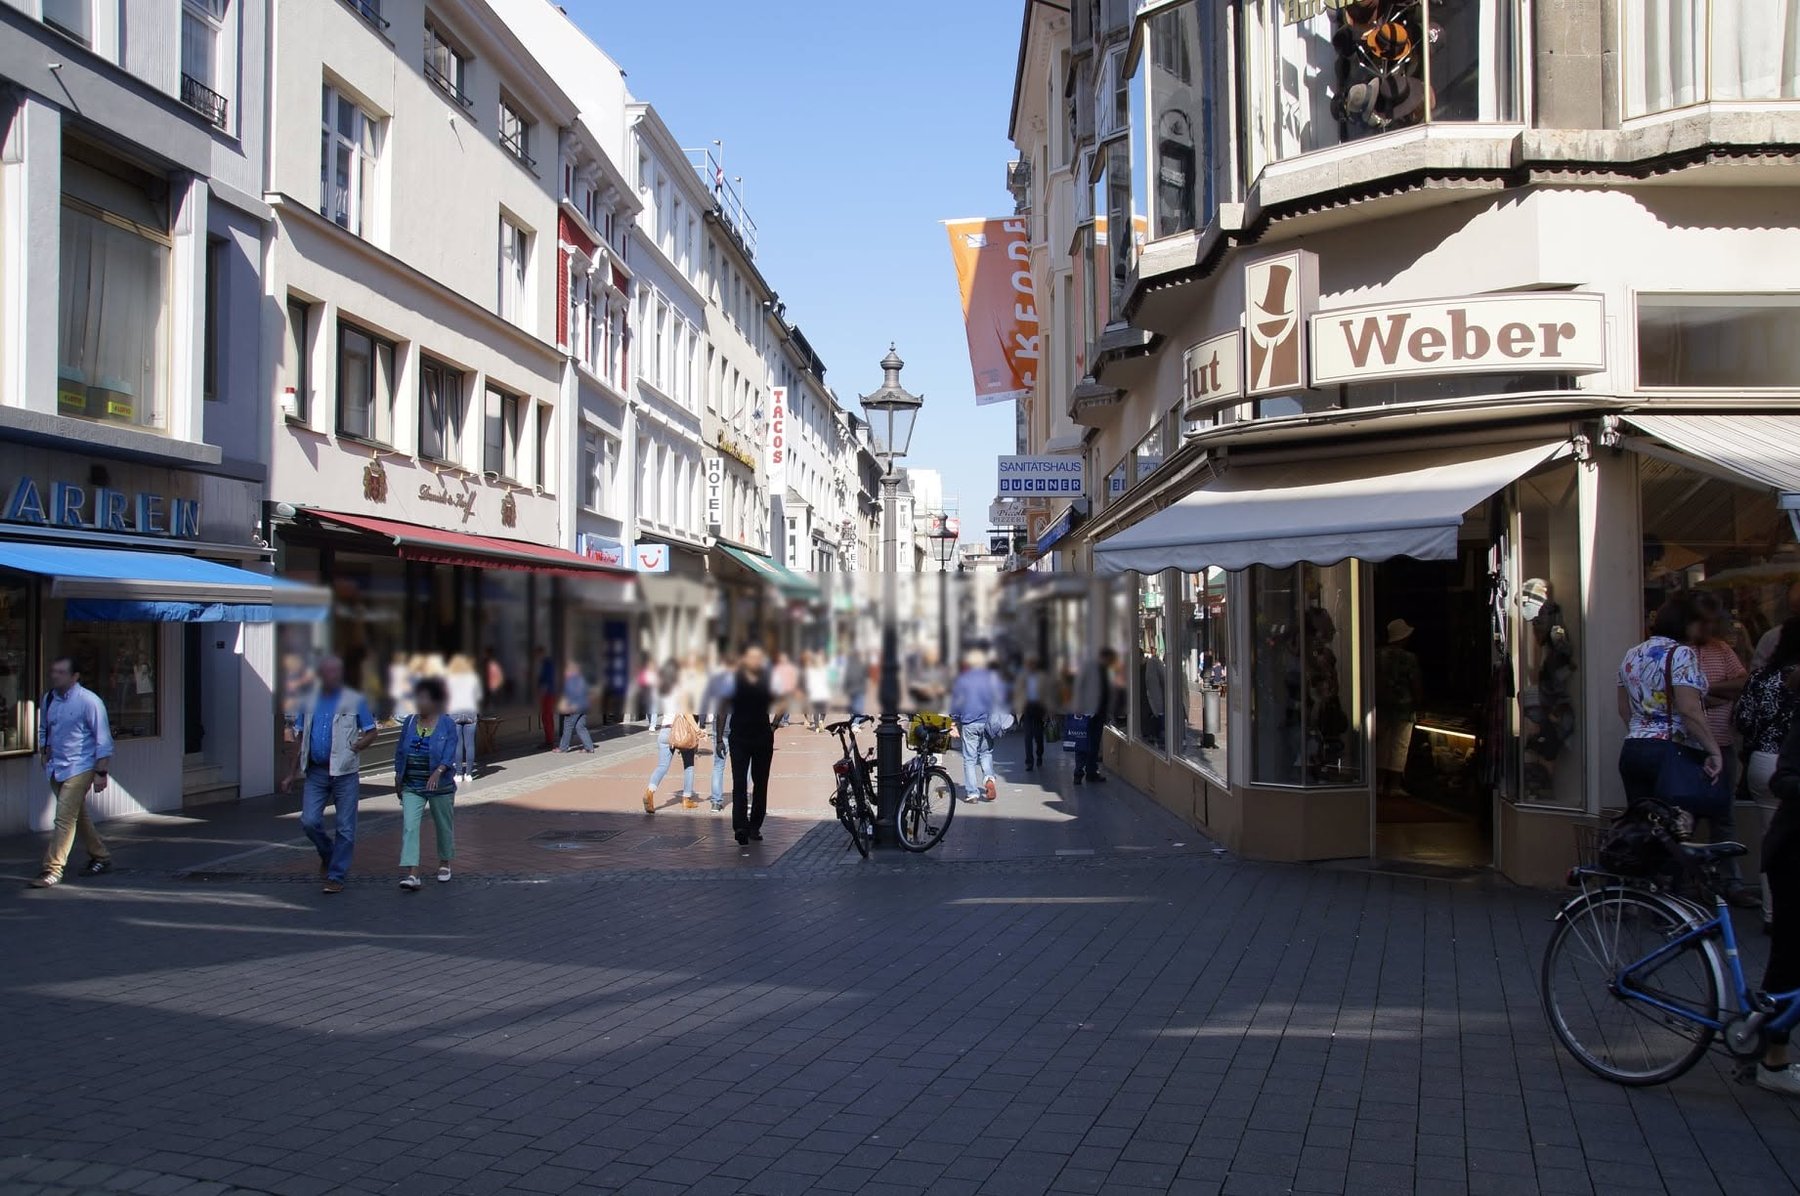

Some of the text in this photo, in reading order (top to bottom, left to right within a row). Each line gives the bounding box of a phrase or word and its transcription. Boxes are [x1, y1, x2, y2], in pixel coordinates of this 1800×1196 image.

[1339, 308, 1576, 368] Weber
[773, 390, 784, 464] TACOS
[3, 475, 201, 538] ARREN
[708, 459, 721, 523] HOTEL
[1001, 479, 1081, 491] BUCHNER
